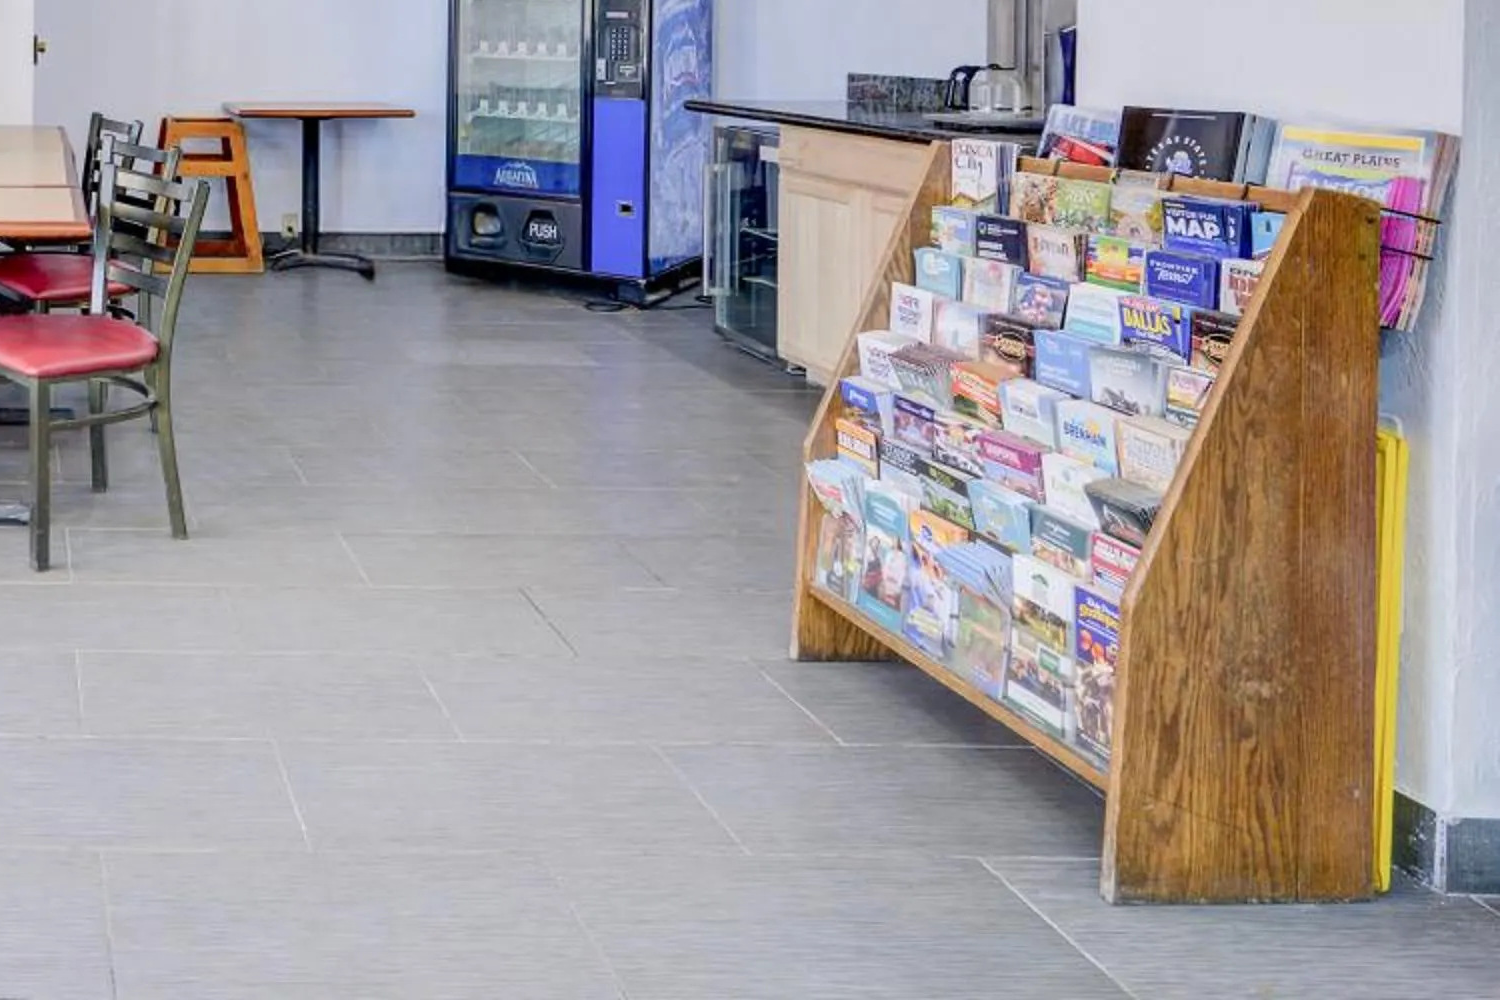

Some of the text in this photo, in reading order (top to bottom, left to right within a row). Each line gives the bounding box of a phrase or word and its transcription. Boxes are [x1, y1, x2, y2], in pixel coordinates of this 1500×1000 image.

[1302, 149, 1401, 168] GREAT PLAINS
[529, 221, 558, 240] PUSH
[1165, 215, 1221, 240] MAP
[1123, 306, 1173, 337] DALLAS
